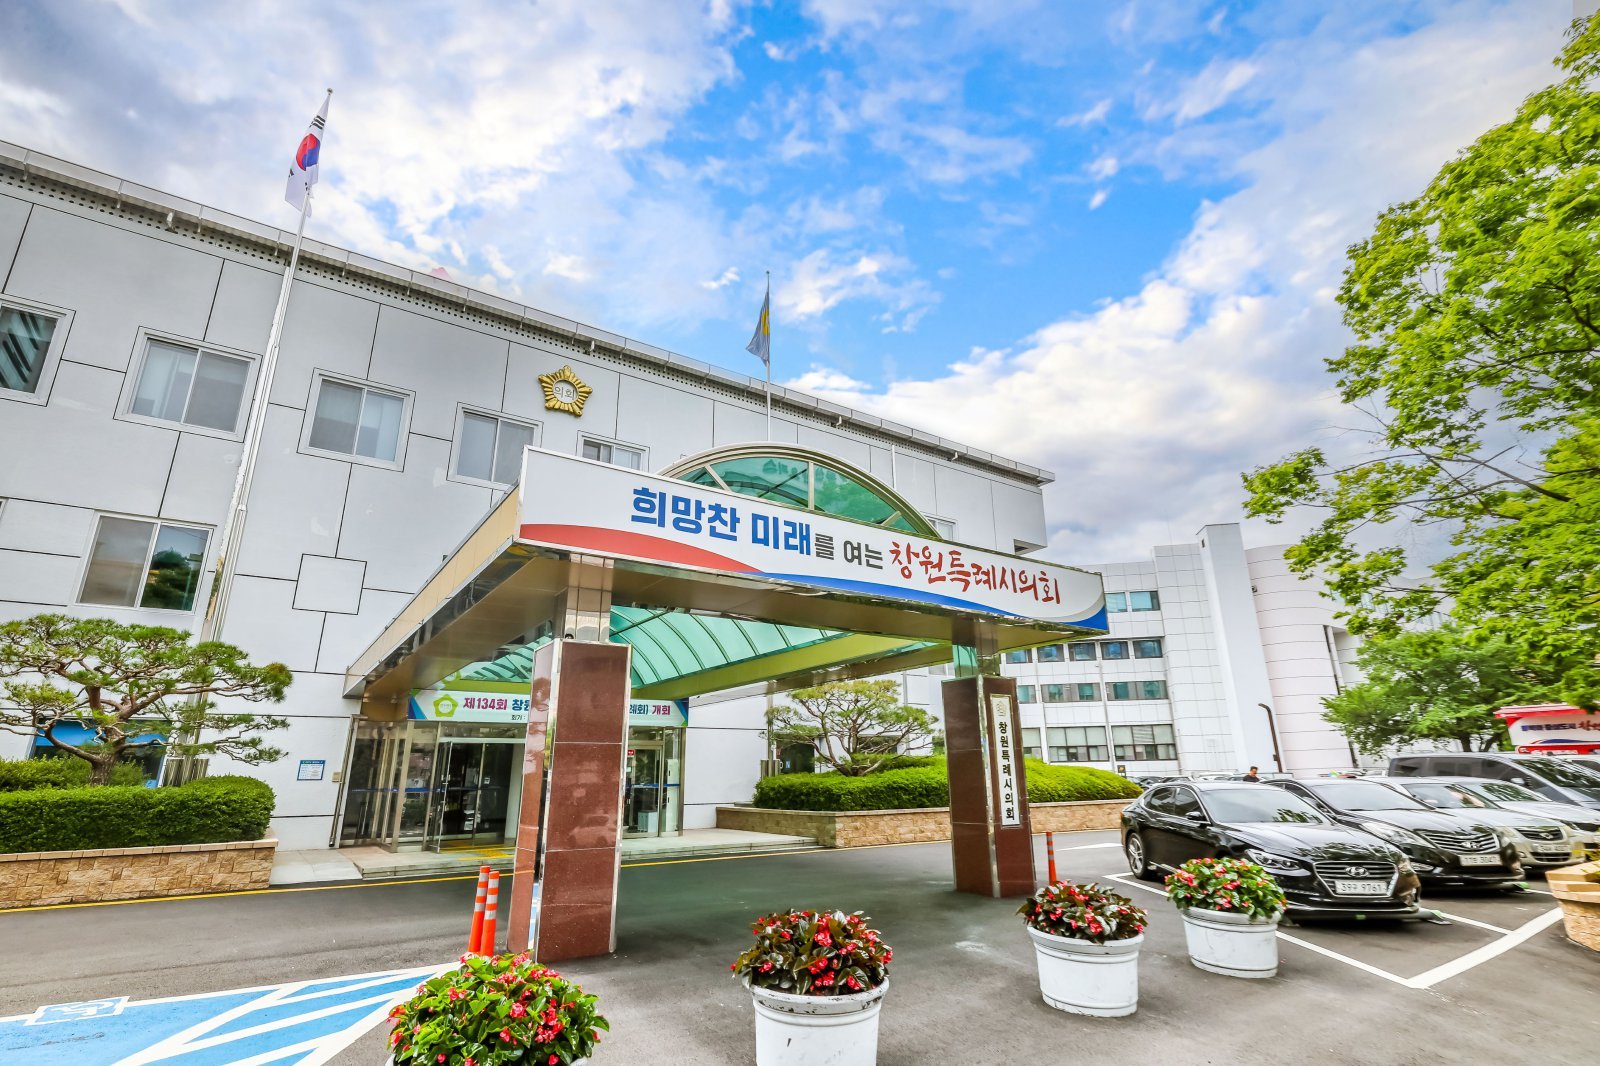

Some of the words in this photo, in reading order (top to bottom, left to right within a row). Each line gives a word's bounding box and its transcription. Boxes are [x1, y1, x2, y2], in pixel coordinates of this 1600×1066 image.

[631, 487, 741, 542] 희망찬
[751, 512, 835, 561] 미래를
[843, 539, 884, 570] 여는
[889, 540, 1061, 605] 창원특례시의회
[462, 697, 508, 711] 제134회
[652, 704, 671, 716] 개회
[998, 721, 1015, 821] 창원특례시의회
